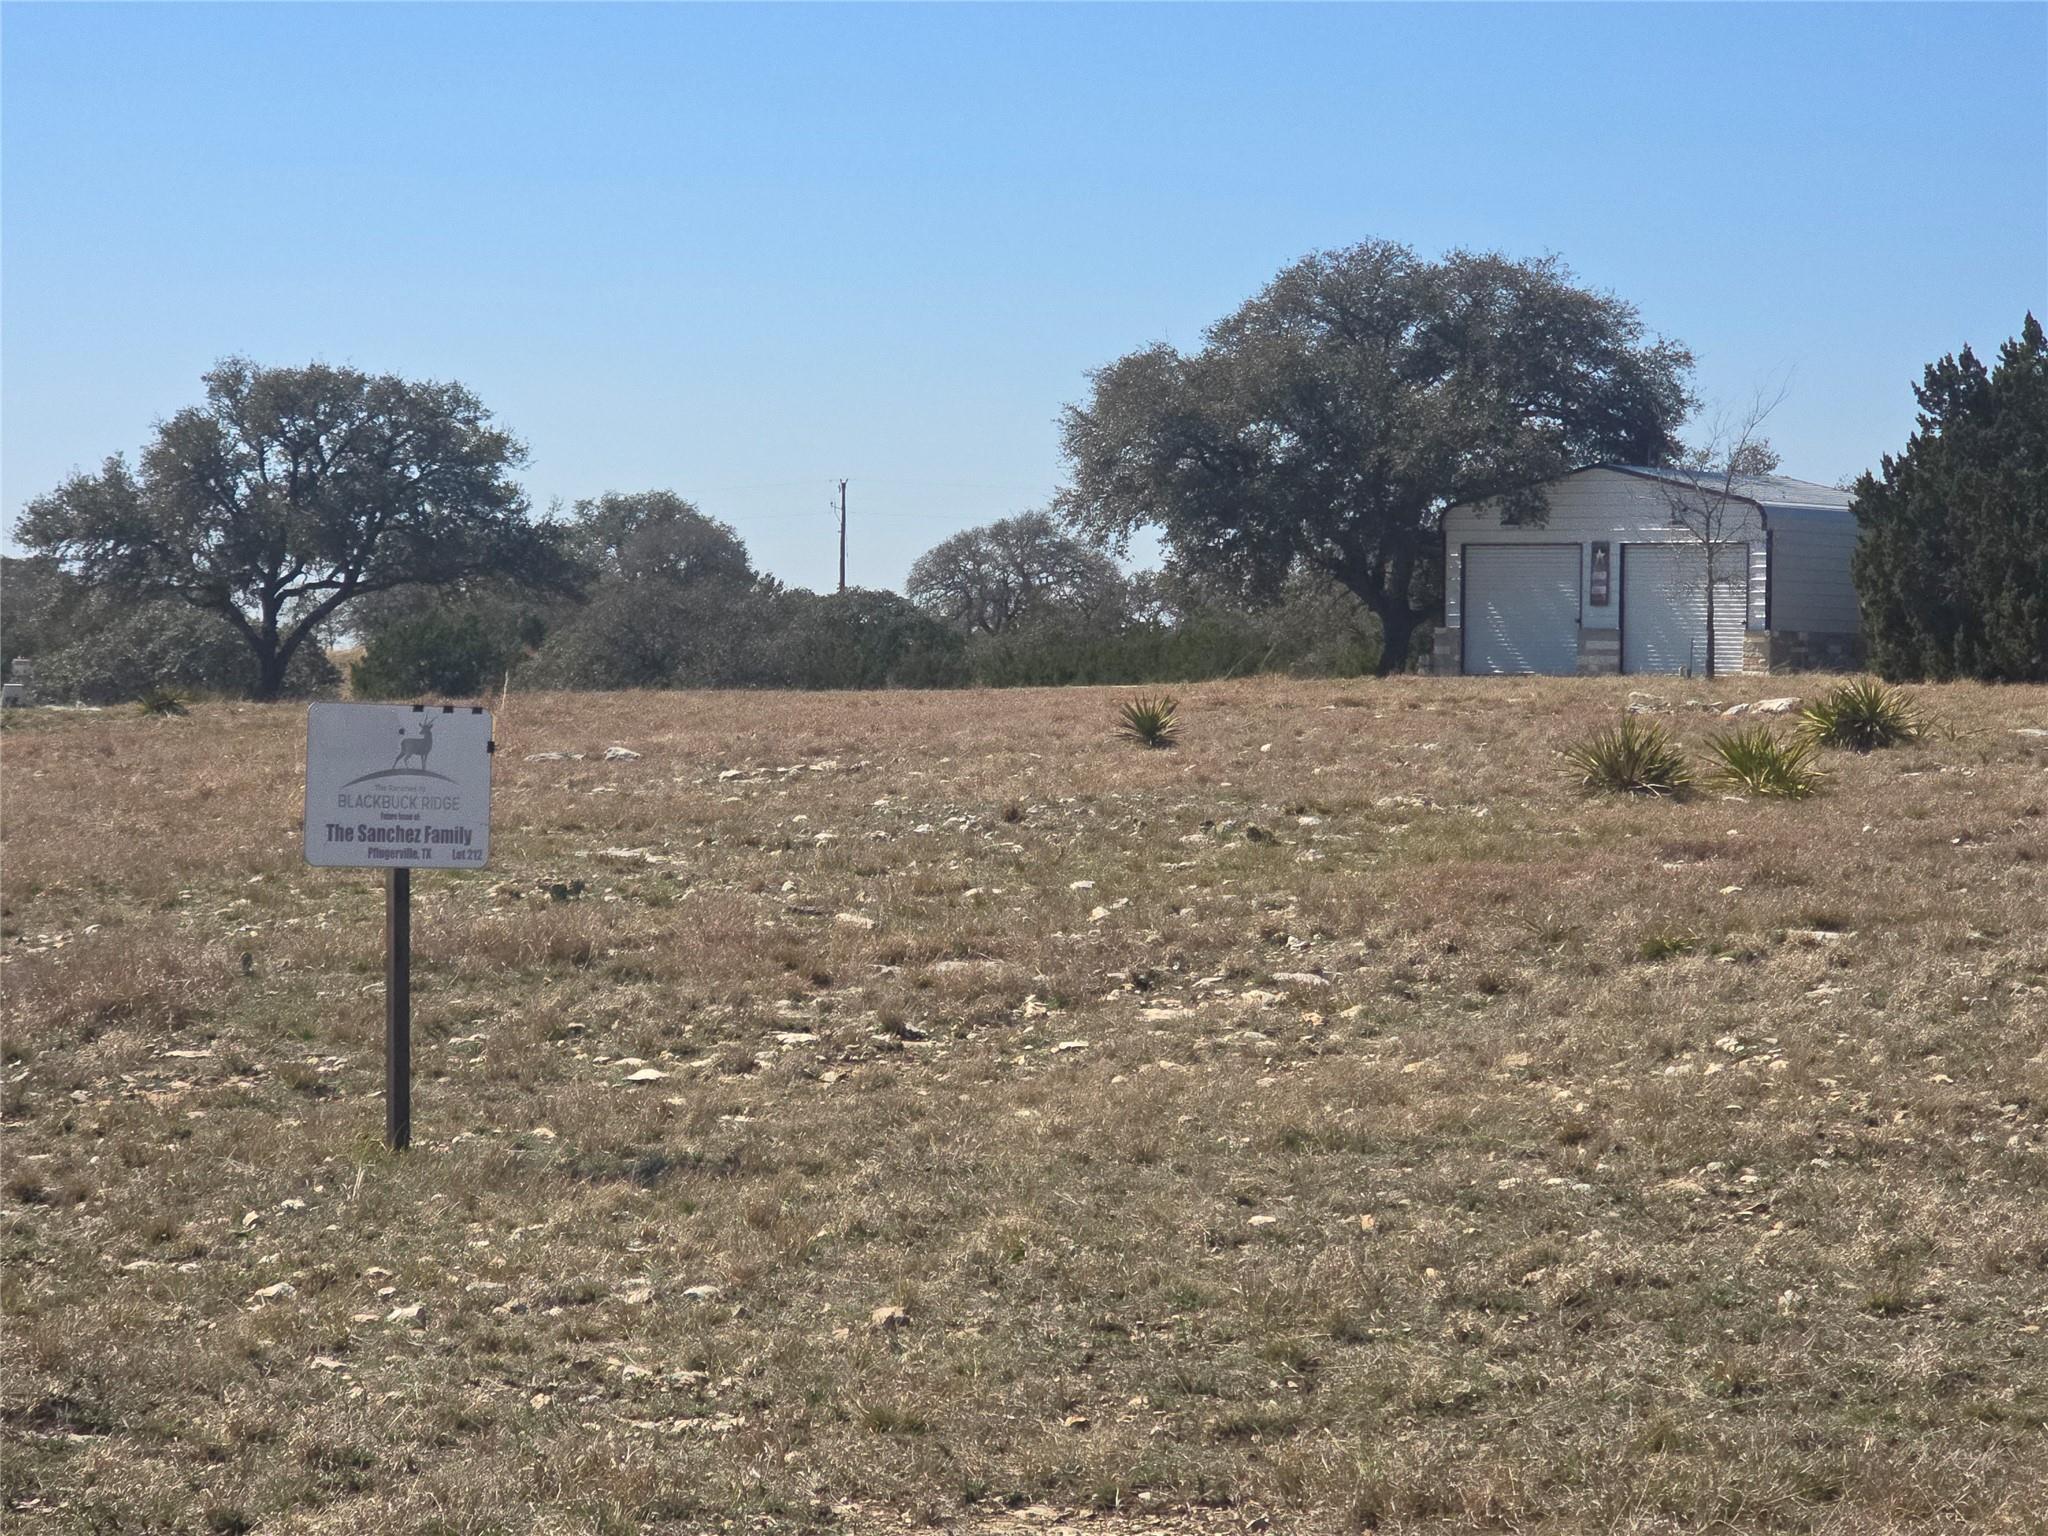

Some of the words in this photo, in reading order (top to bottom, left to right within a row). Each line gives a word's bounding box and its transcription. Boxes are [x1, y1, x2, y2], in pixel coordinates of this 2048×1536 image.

[338, 794, 418, 809] BLACKBUCK
[421, 796, 460, 810] RIDGE
[326, 823, 354, 842] The
[358, 824, 421, 844] Sanchez
[424, 825, 472, 846] Family
[422, 848, 432, 860] TX
[452, 849, 466, 860] Lot
[467, 849, 483, 860] 212
